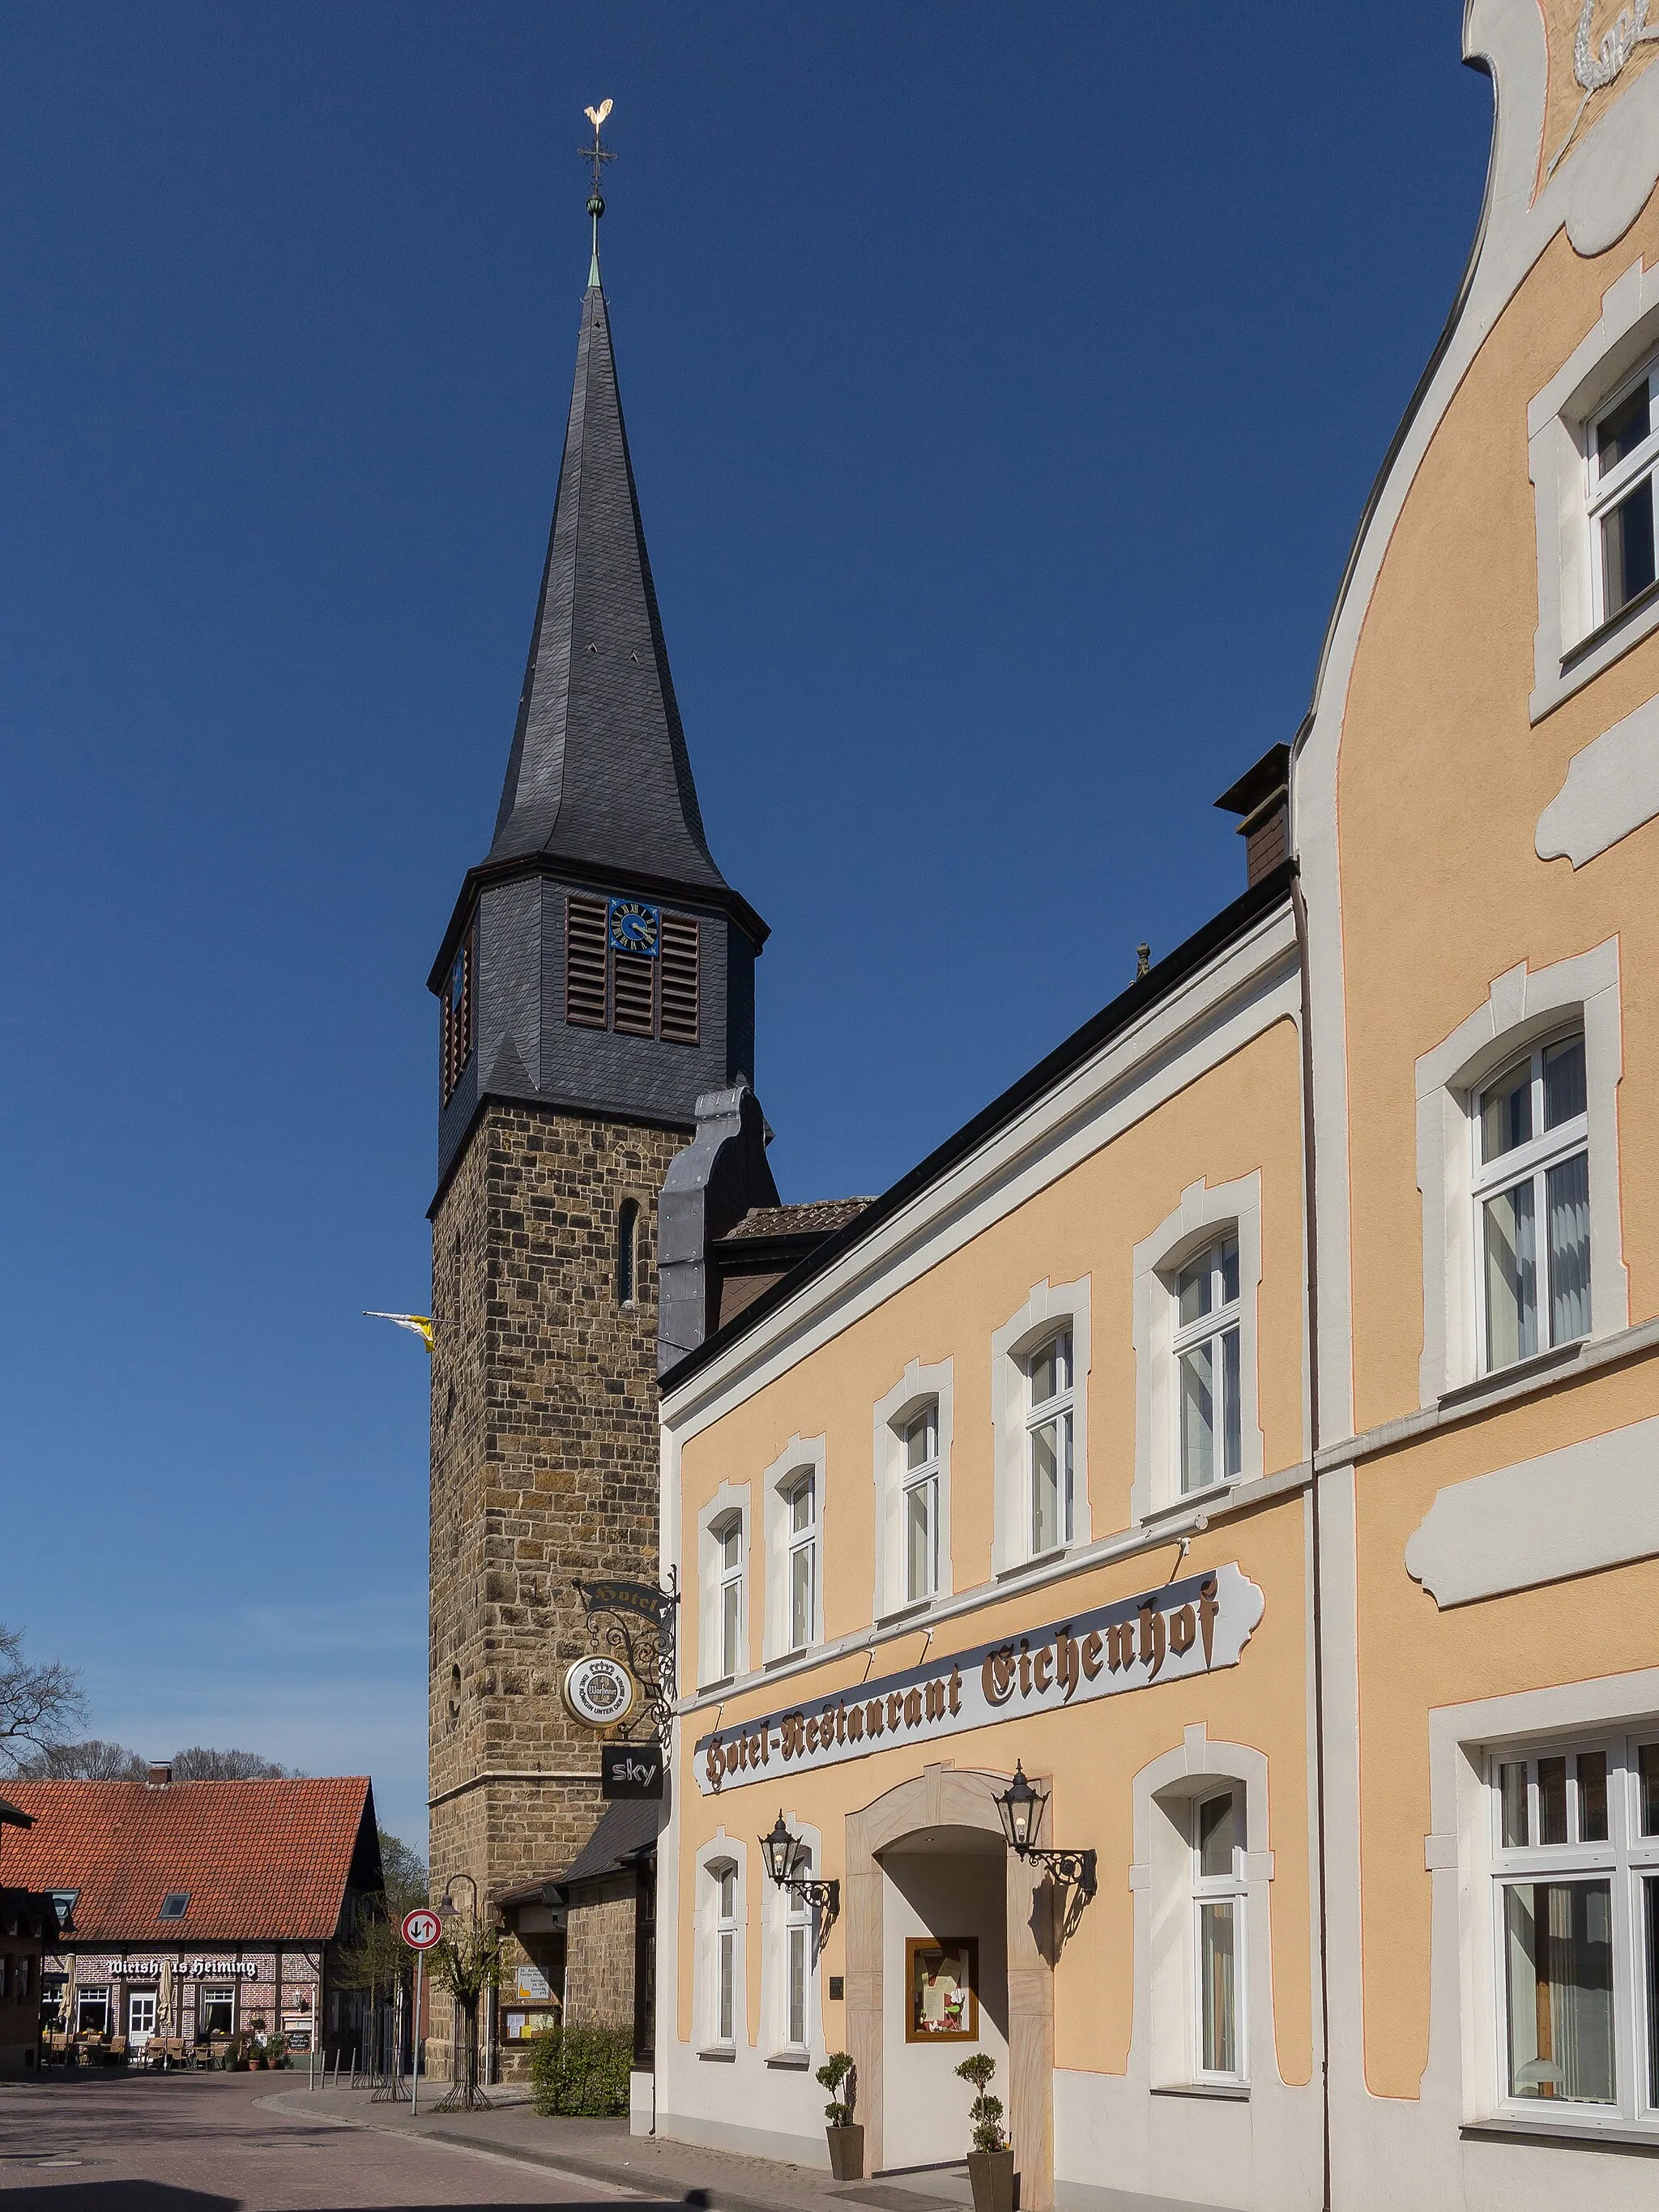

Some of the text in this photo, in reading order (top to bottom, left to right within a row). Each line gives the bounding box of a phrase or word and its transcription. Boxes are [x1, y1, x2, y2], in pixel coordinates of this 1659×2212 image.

[595, 1586, 659, 1612] Hotel
[982, 1579, 1219, 1707] Eichenhof
[579, 1673, 590, 1687] EINE
[579, 1688, 594, 1711] KÖNIGIN
[613, 1697, 624, 1710] DEN
[594, 1706, 614, 1715] UNTER
[612, 1758, 656, 1787] sky
[189, 1959, 257, 1976] Heiming
